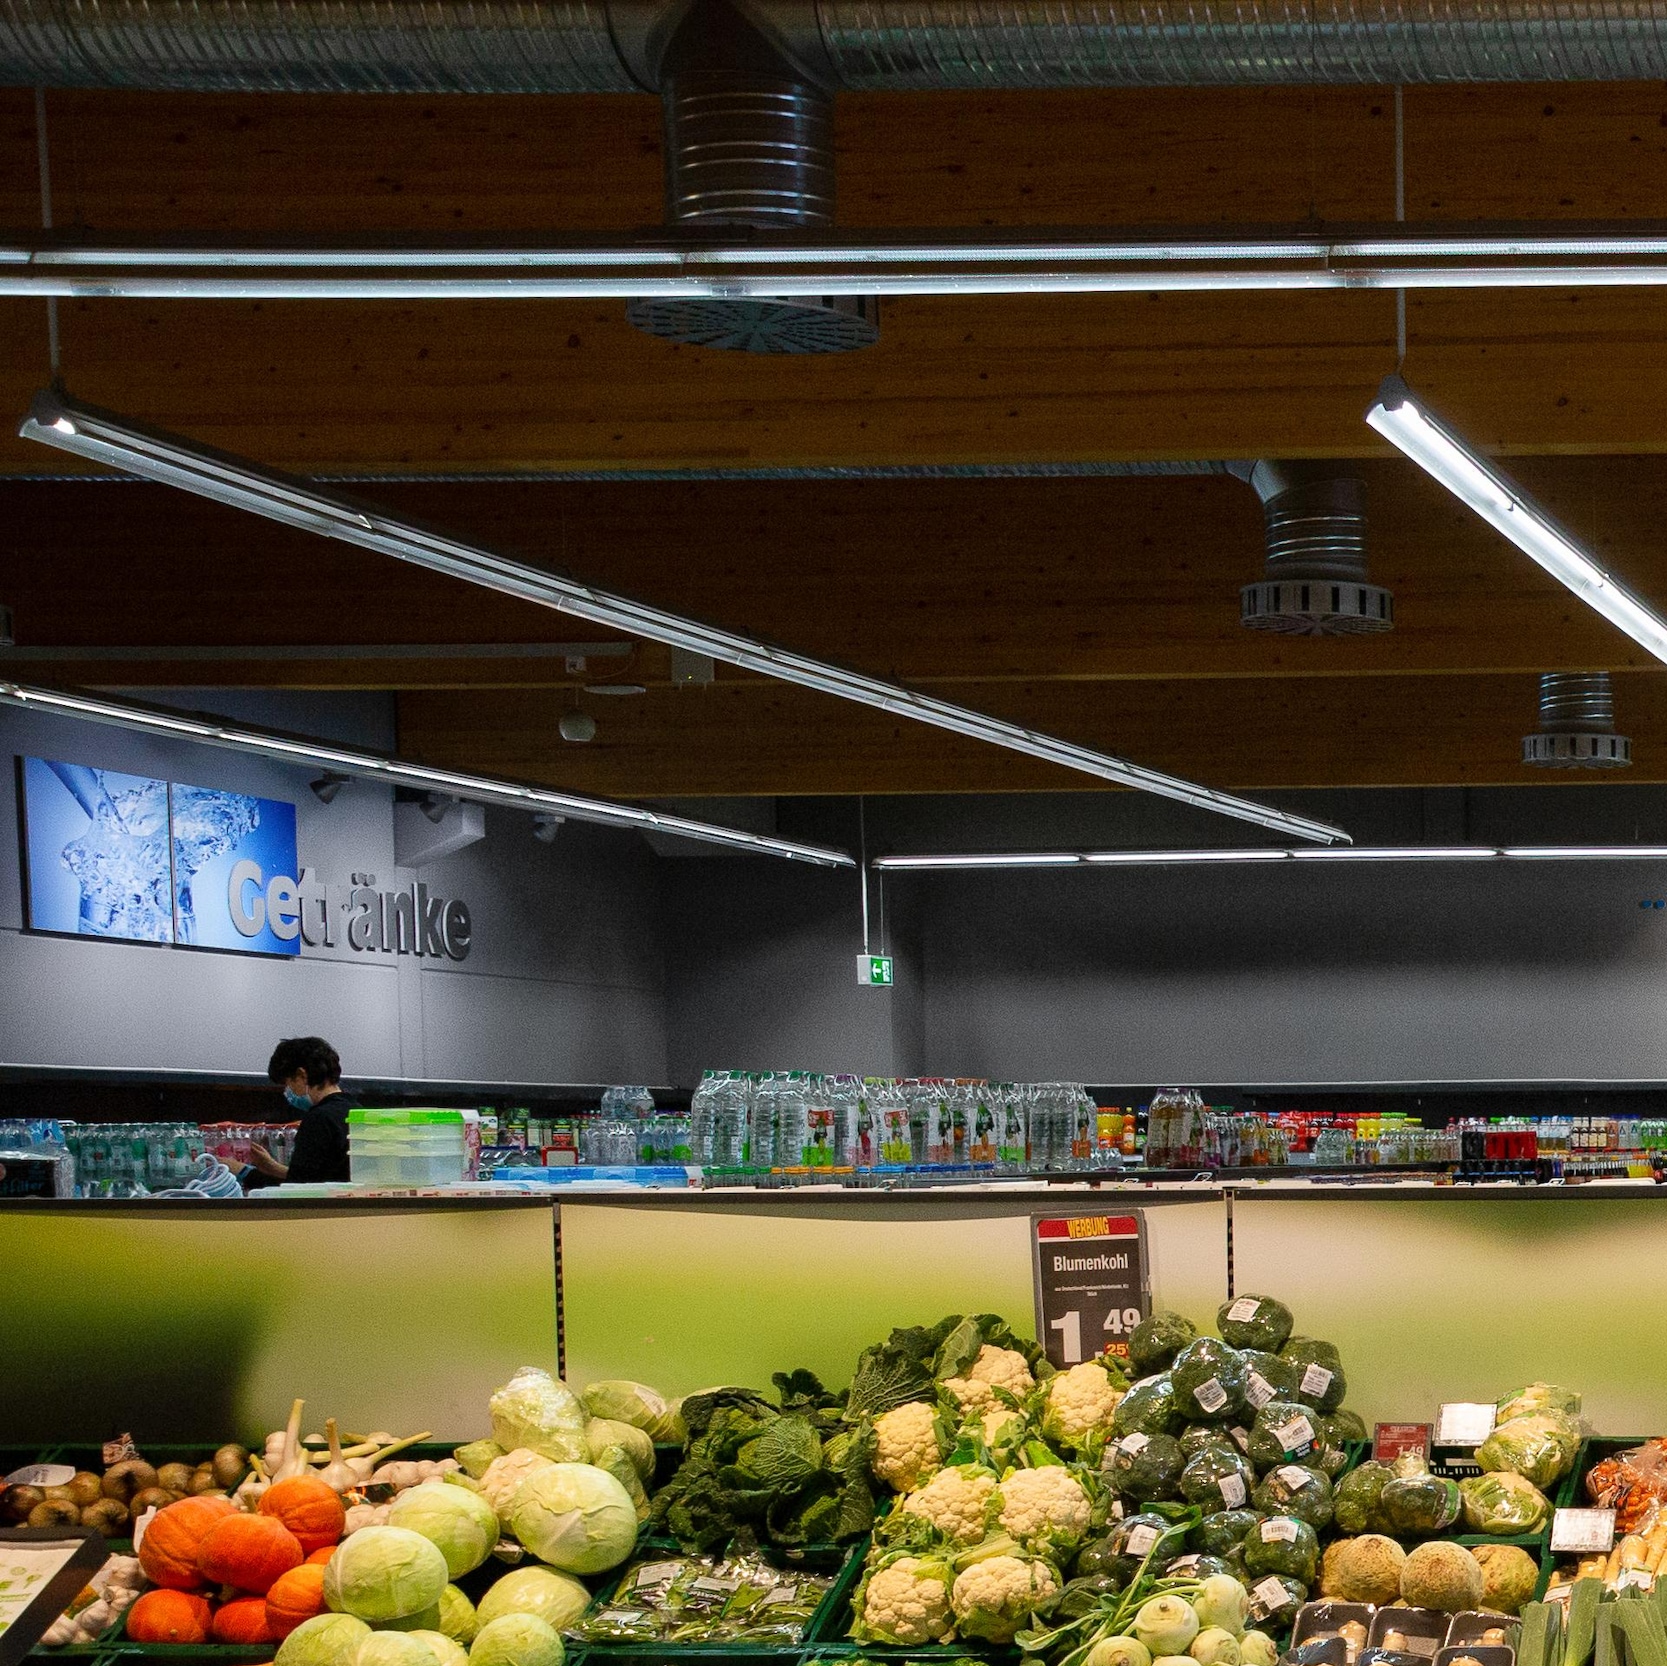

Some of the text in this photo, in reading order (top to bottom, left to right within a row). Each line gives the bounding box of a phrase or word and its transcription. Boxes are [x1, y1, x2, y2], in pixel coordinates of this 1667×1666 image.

[228, 859, 472, 962] Getränke
[1067, 1216, 1110, 1239] WERBUNG
[1053, 1253, 1129, 1272] Blumenkohl
